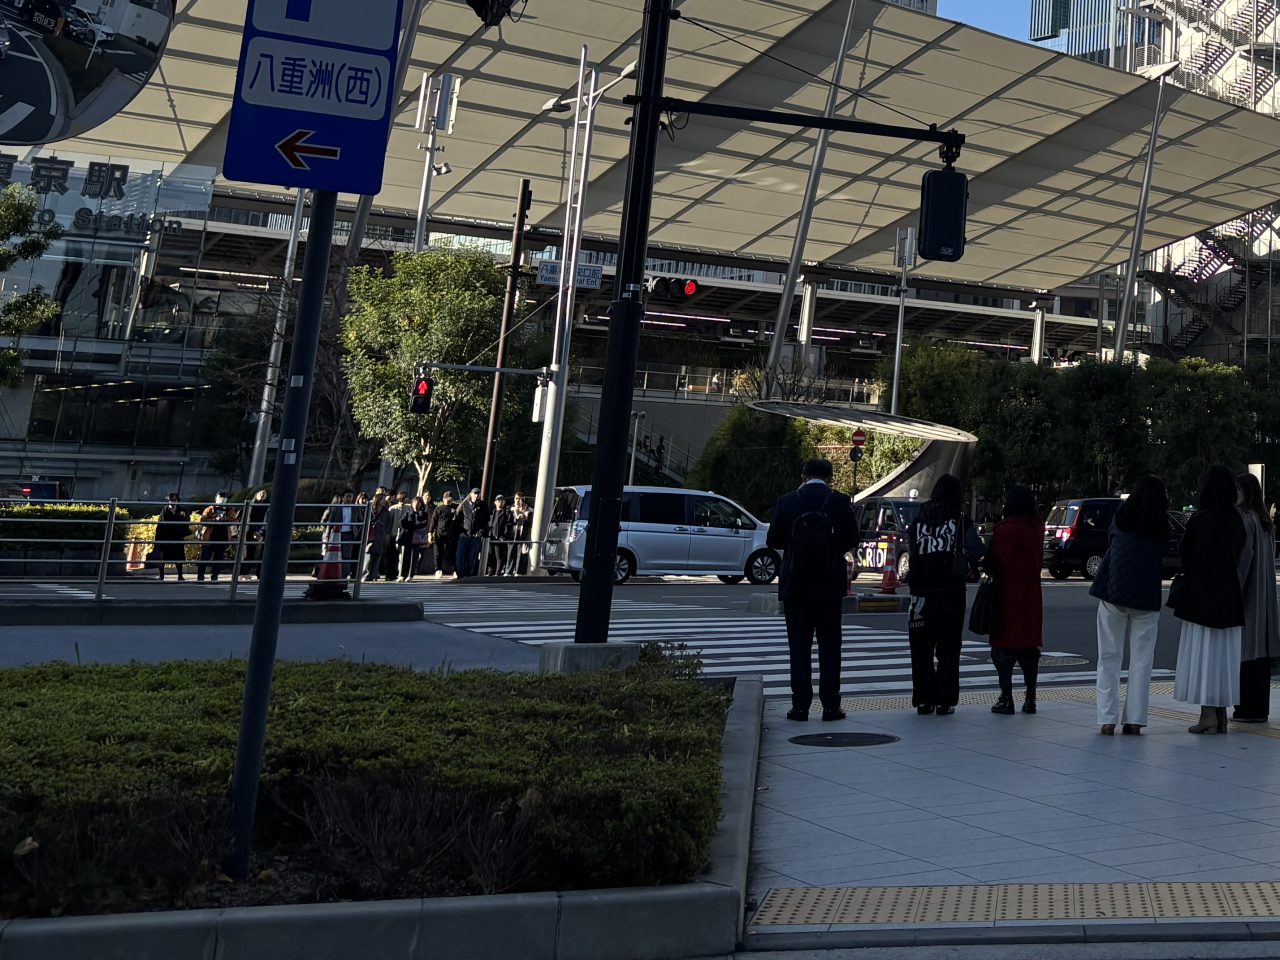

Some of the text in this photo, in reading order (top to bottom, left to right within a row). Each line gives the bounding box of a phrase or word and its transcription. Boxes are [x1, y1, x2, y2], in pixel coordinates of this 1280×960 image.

[249, 52, 381, 108] 八重洲(西)
[74, 207, 183, 235] Station
